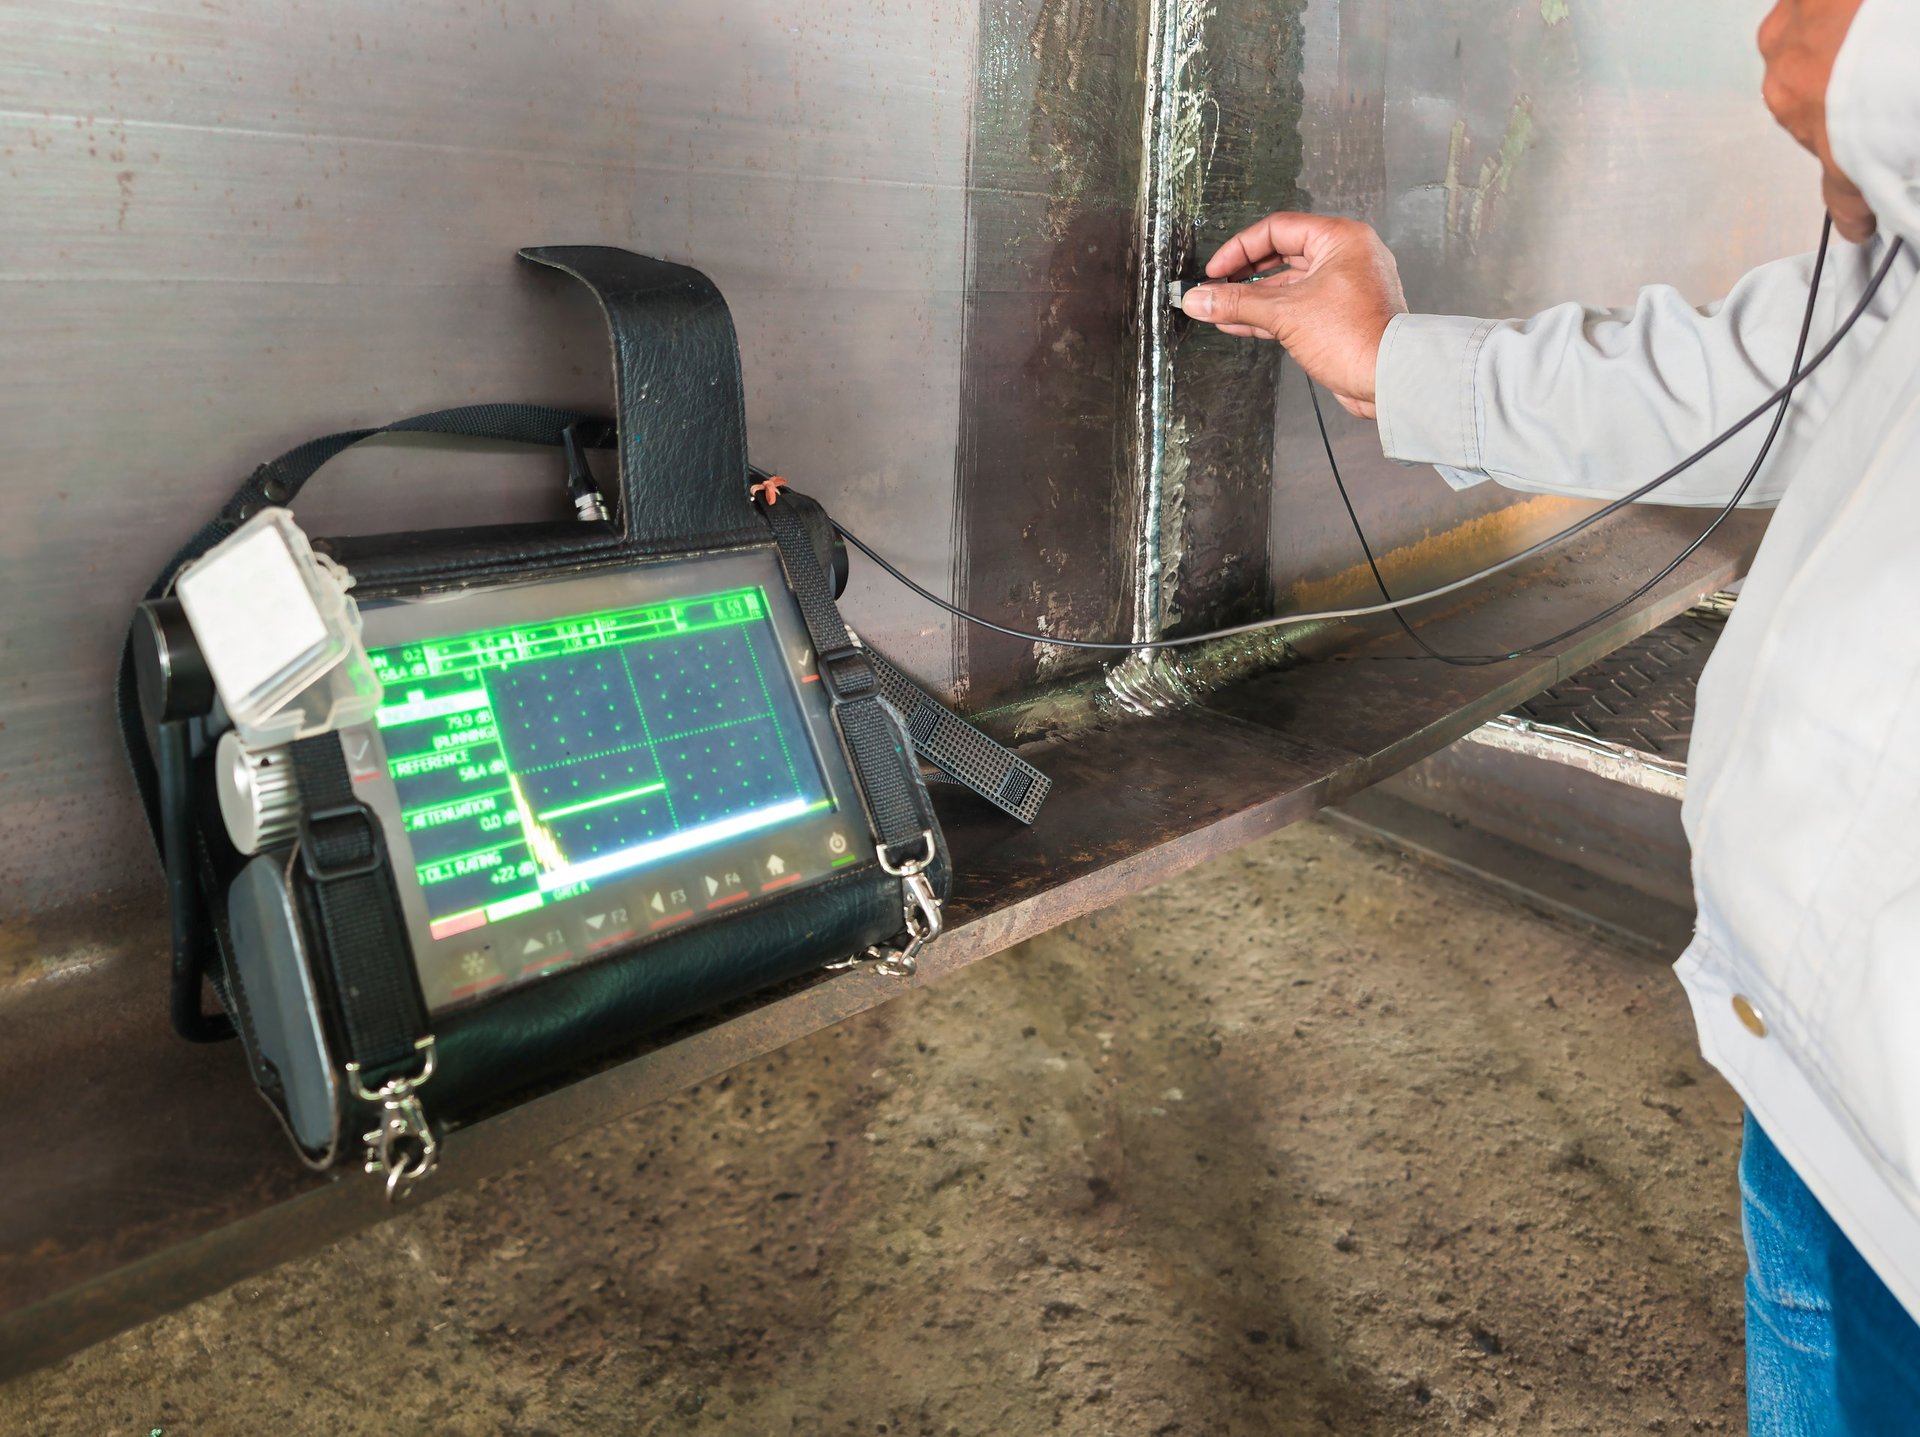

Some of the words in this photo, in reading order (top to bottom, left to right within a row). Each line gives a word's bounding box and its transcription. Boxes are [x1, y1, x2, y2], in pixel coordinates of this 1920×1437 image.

[396, 749, 471, 777] REFERENCE
[412, 797, 496, 830] ATTENUATION
[480, 813, 502, 831] 0.0
[490, 865, 517, 884] +22
[725, 872, 741, 886] F4
[670, 889, 687, 904] F3
[611, 908, 628, 925] F2
[546, 929, 565, 946] F1
